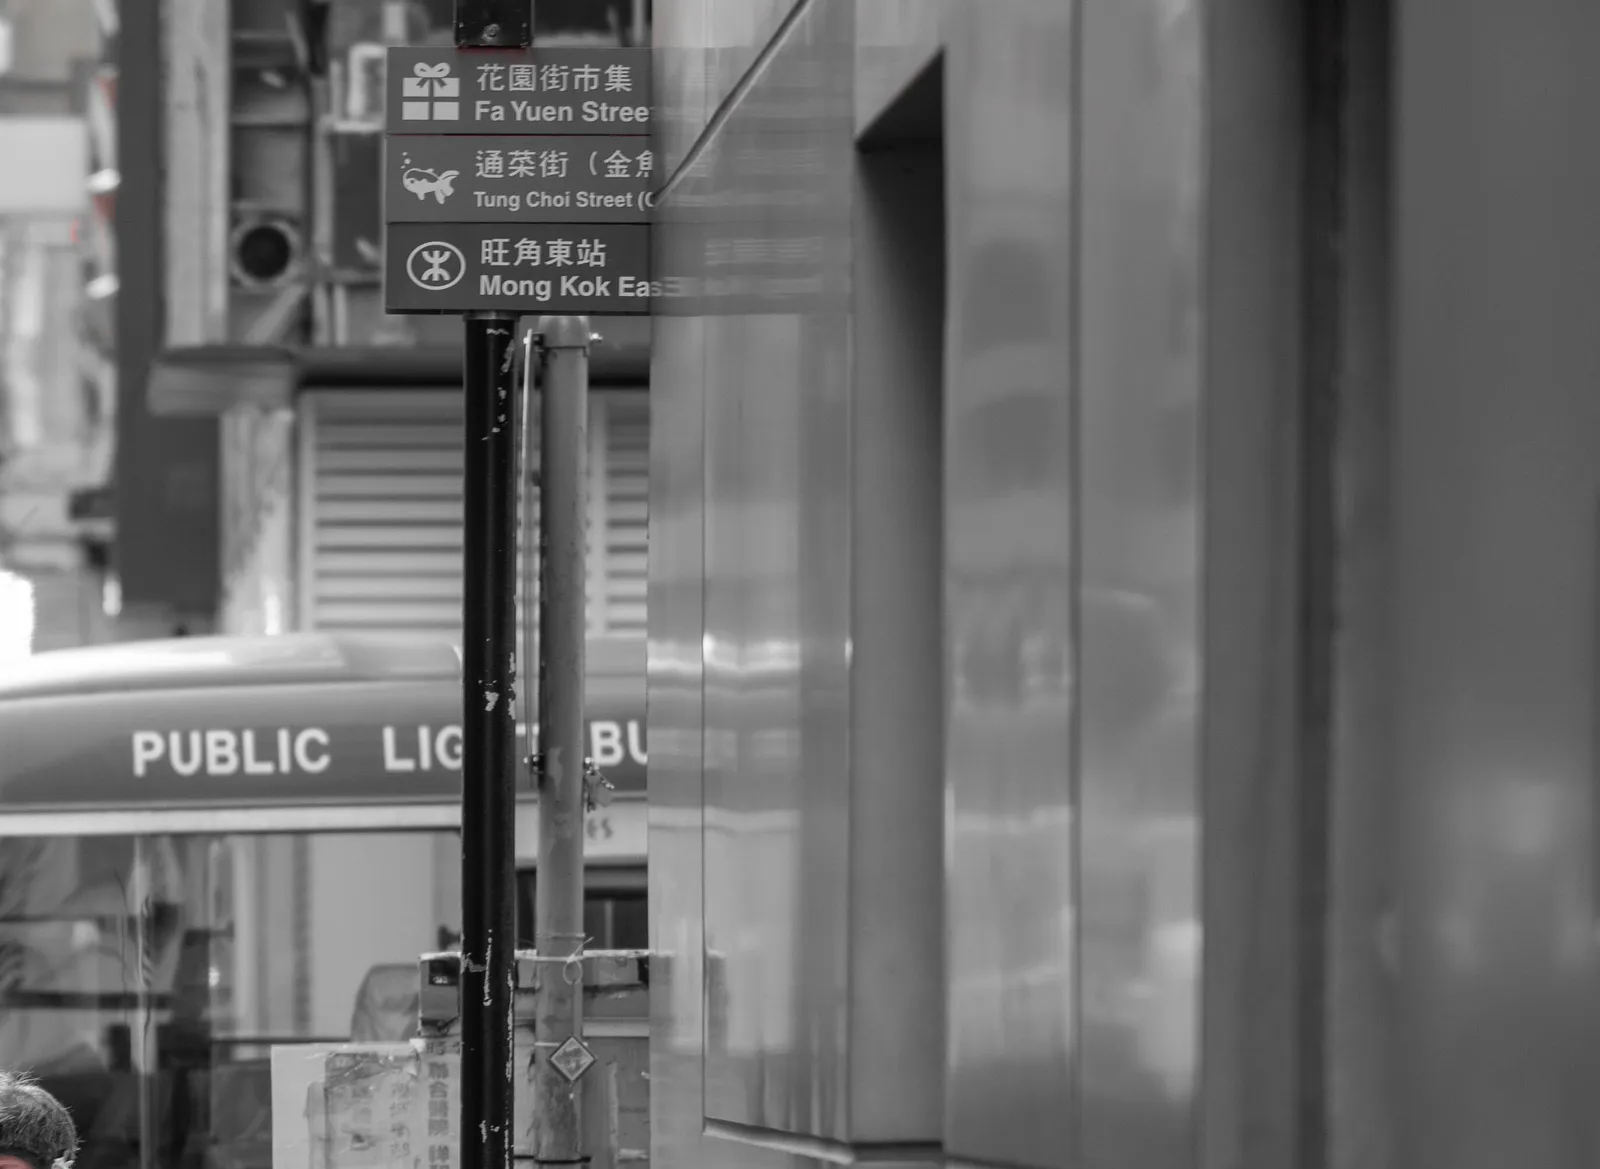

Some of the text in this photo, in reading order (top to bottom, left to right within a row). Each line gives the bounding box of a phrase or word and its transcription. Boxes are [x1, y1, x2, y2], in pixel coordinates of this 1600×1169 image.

[476, 64, 633, 92] 花園街市集
[474, 101, 505, 122] Fa
[510, 101, 574, 122] Yuen
[473, 192, 521, 211] Tung
[526, 192, 571, 207] Choi
[576, 192, 633, 208] Street
[480, 238, 607, 268] 旺角東站
[479, 275, 552, 301] Mong
[560, 275, 611, 297] Kok
[132, 728, 331, 777] PUBLIC
